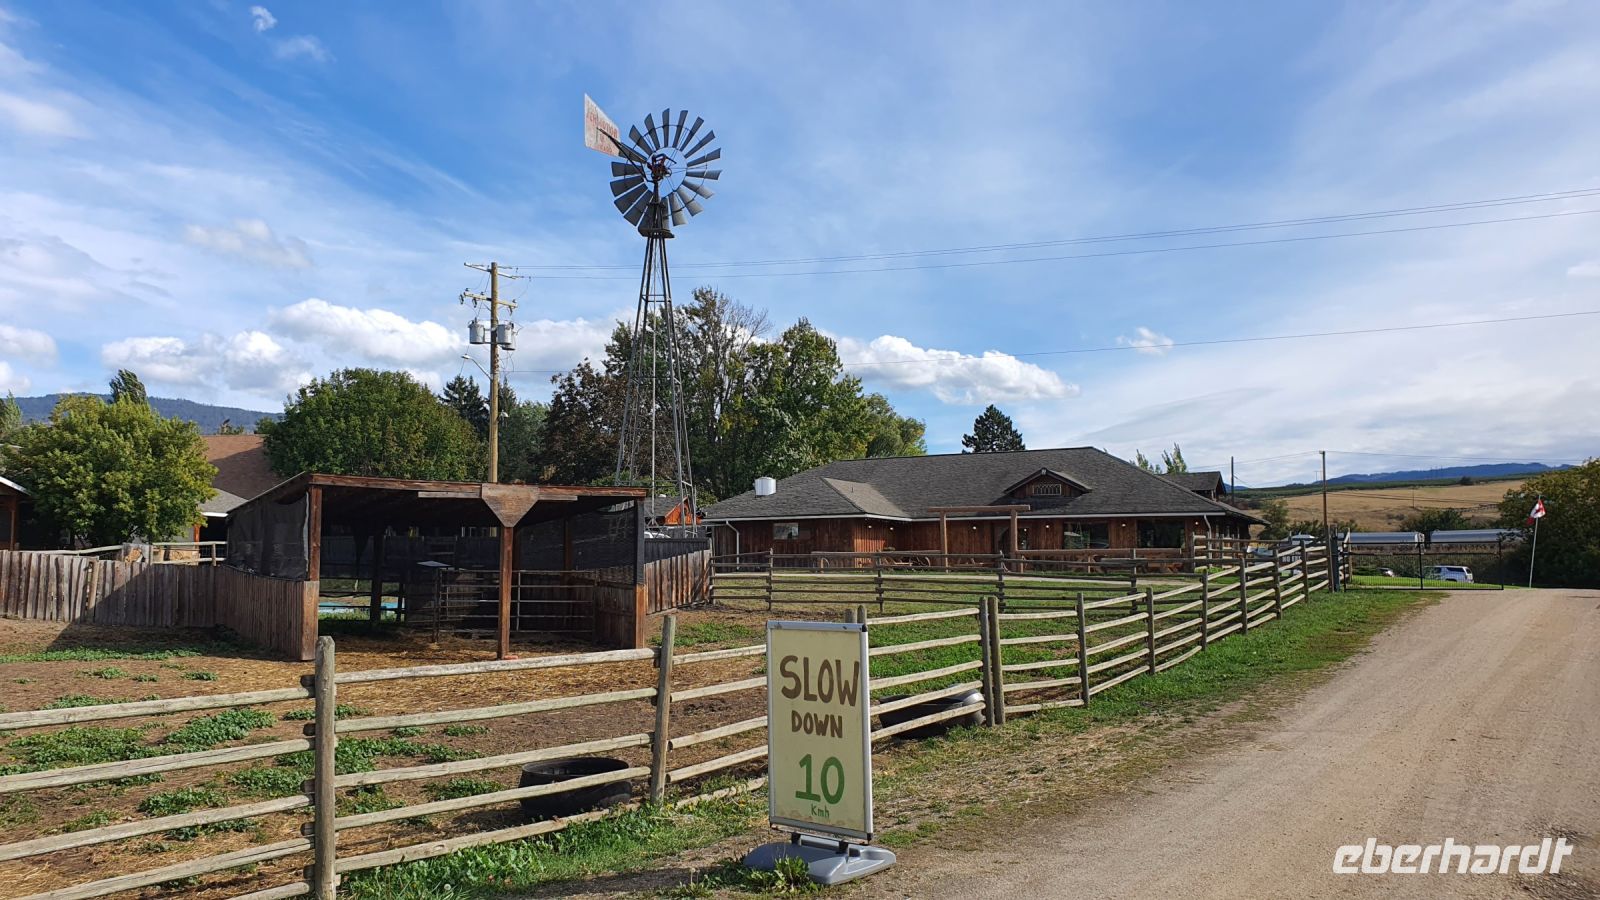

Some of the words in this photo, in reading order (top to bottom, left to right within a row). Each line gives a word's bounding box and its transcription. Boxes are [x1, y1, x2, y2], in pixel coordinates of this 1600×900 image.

[780, 655, 859, 706] SLOW
[791, 710, 843, 738] DOWN
[795, 754, 845, 805] 10
